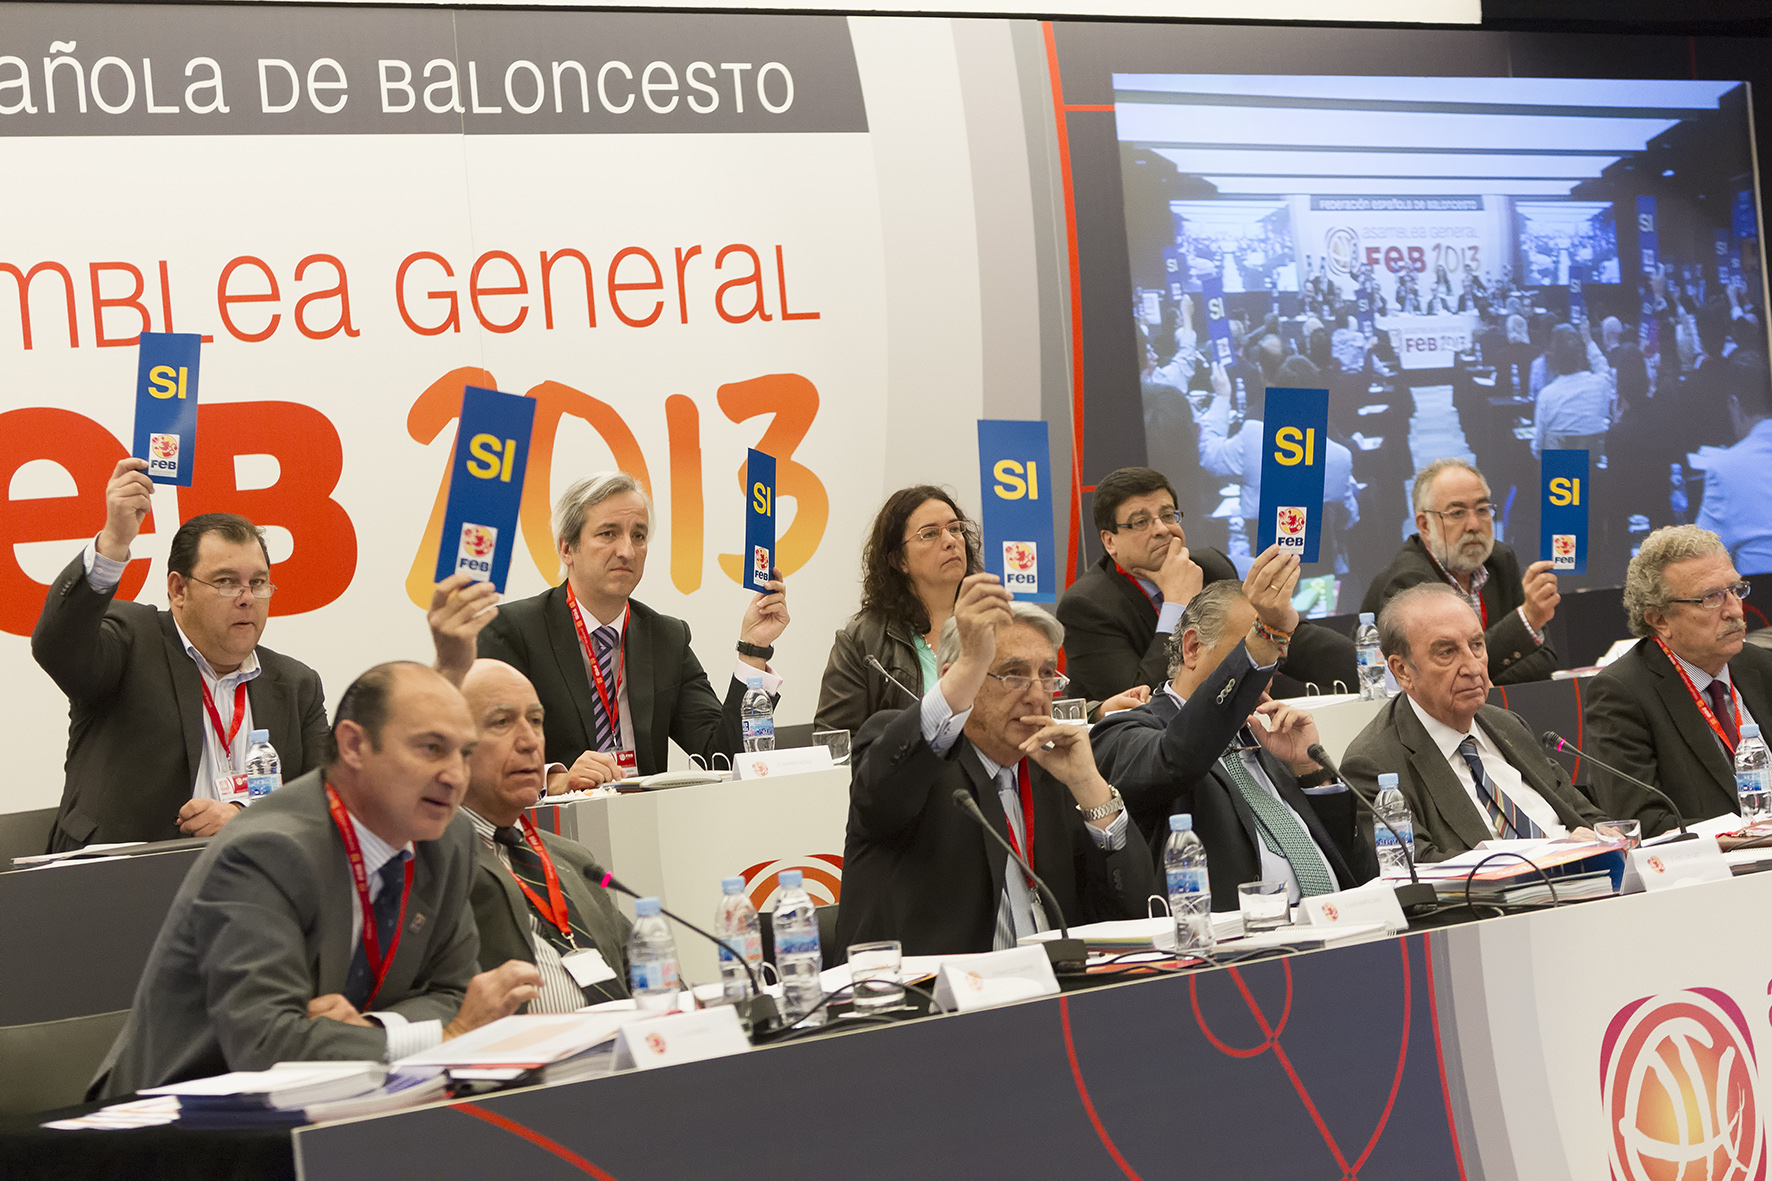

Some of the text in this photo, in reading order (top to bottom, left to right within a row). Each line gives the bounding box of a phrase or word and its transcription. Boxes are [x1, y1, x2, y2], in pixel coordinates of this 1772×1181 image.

[148, 365, 188, 399] SI
[466, 433, 516, 483] SI
[1274, 426, 1315, 466] SI
[993, 459, 1039, 500] SI
[1549, 477, 1580, 506] SI
[753, 482, 771, 517] SI
